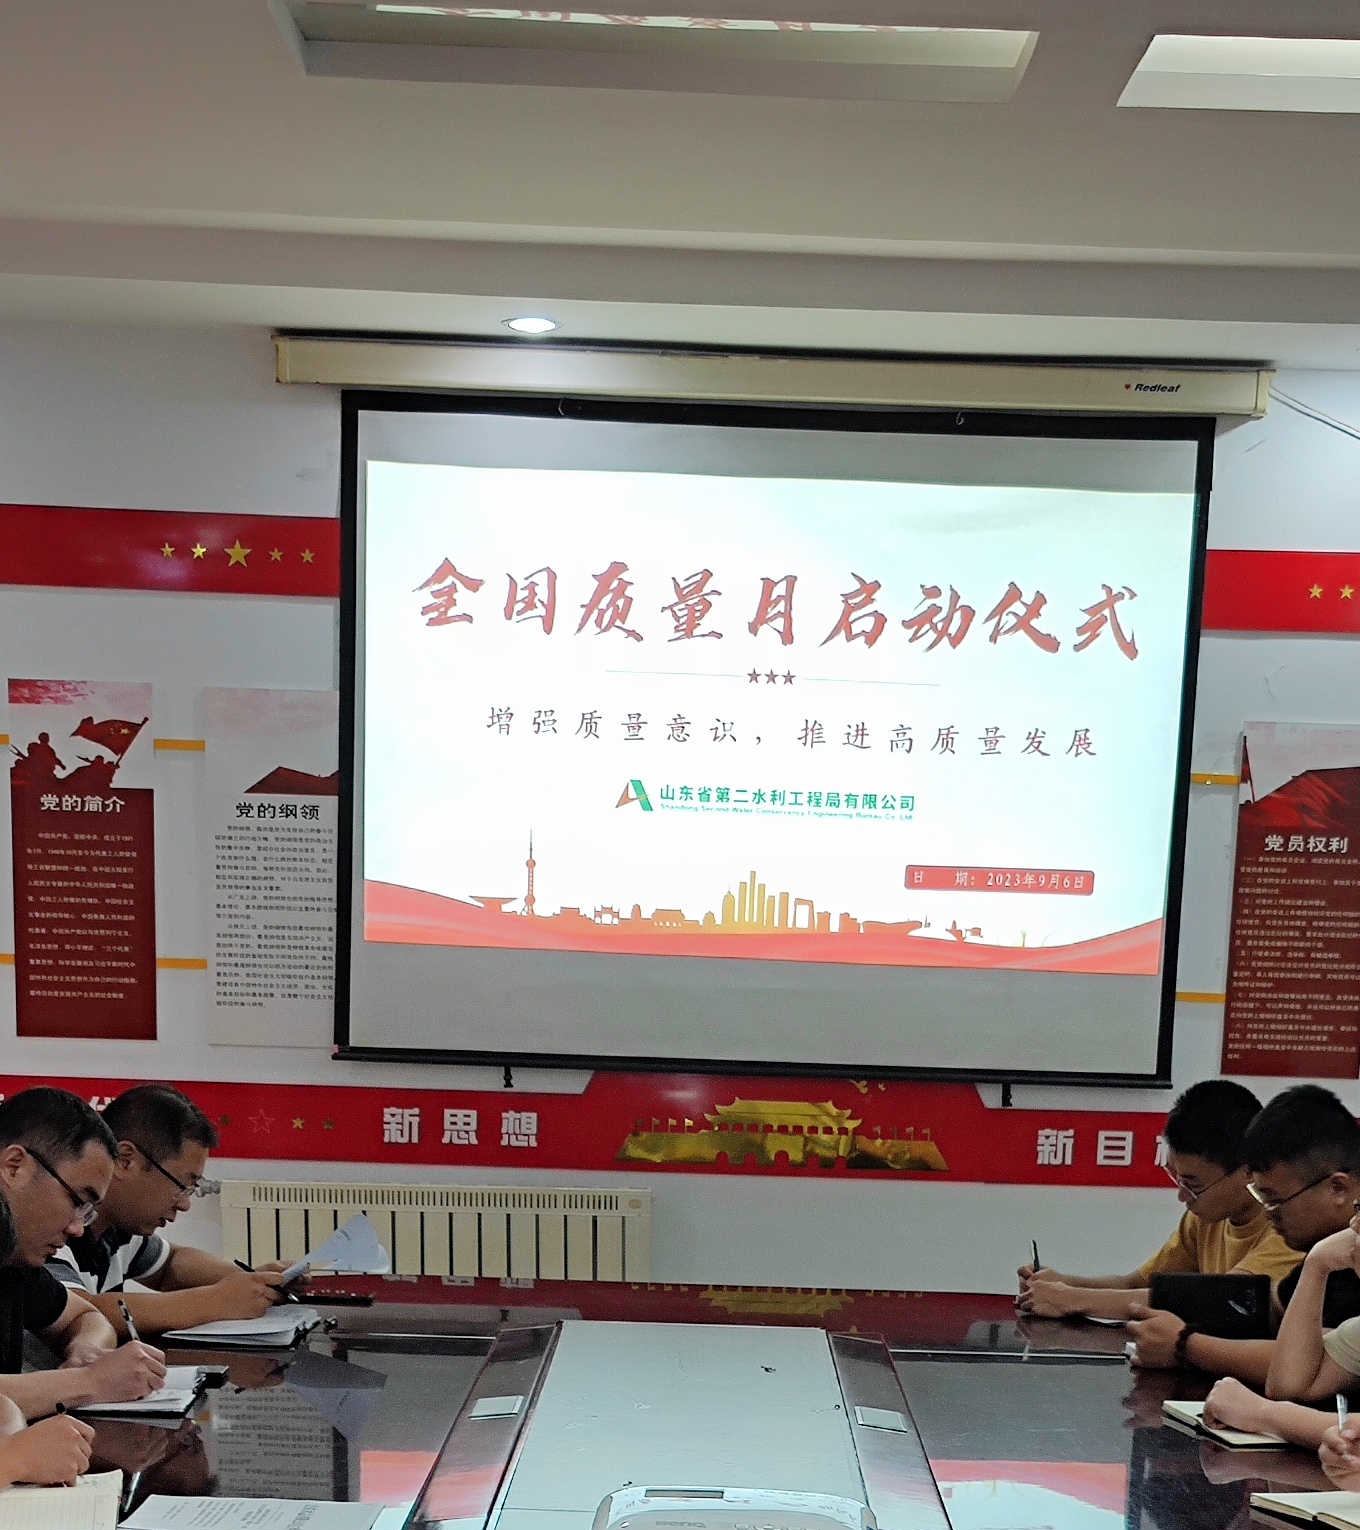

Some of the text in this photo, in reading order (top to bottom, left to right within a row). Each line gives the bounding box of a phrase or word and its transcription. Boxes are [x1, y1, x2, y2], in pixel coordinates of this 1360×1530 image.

[1134, 383, 1181, 393] Redleaf
[412, 556, 1140, 661] 全国质量月启动仪式
[485, 705, 1100, 760] 增强质量意识，推进高质量发展
[40, 794, 125, 813] 党的简介
[659, 783, 916, 812] 山东省第二水利工程局有限公司
[235, 802, 320, 820] 党的纲领
[1264, 835, 1349, 853] 党员权利
[987, 873, 1086, 889] 2023年9月6日
[383, 1107, 538, 1147] 新思想
